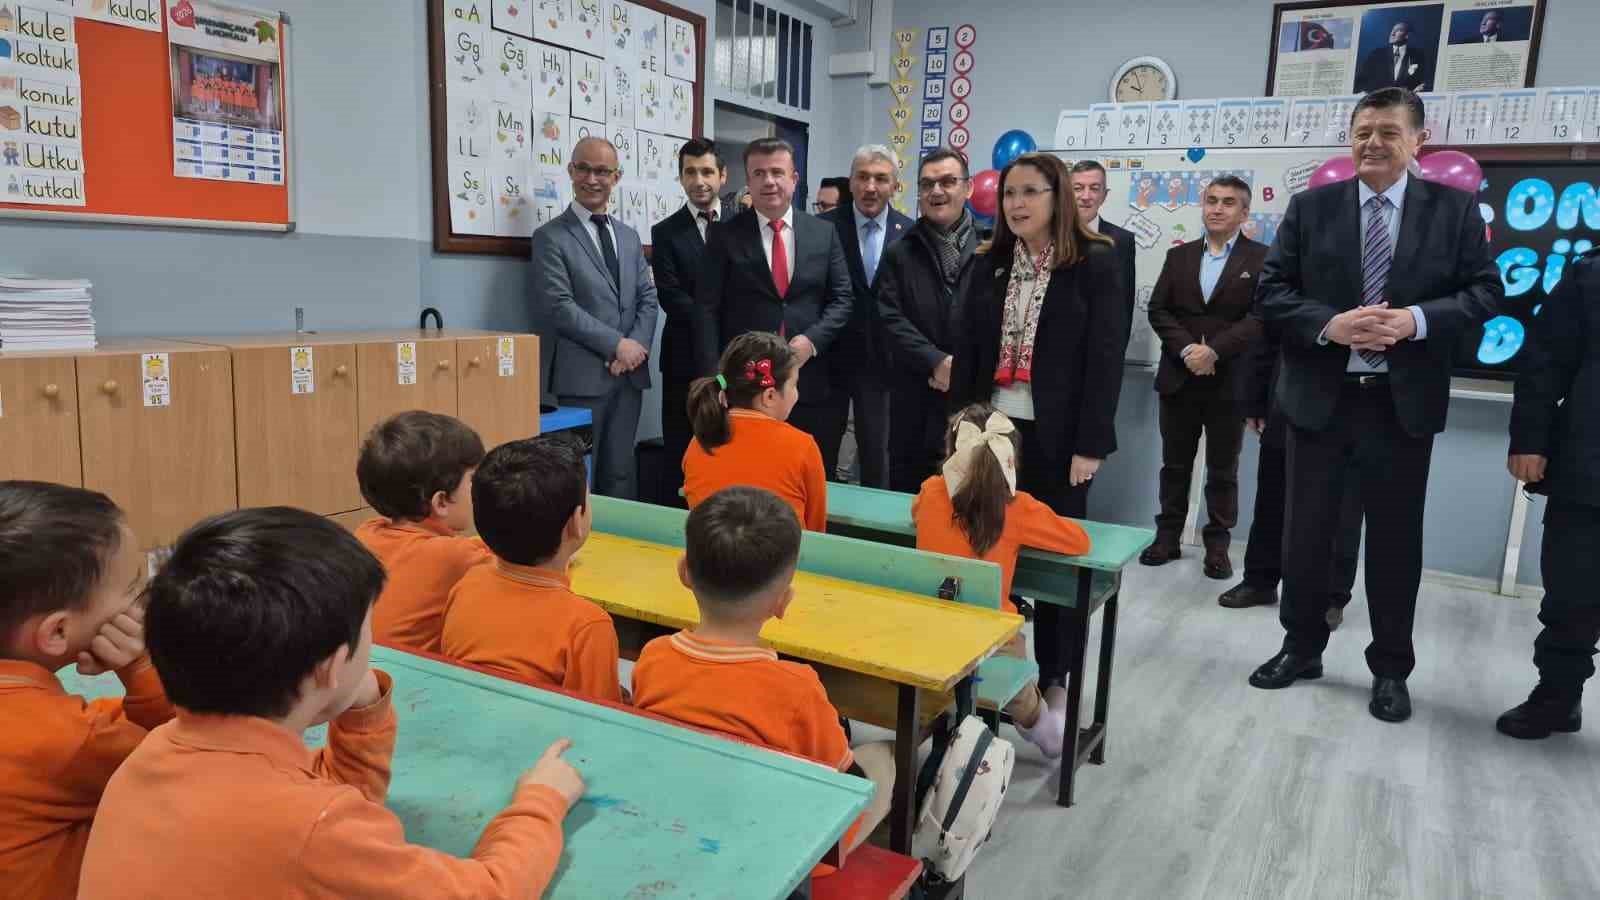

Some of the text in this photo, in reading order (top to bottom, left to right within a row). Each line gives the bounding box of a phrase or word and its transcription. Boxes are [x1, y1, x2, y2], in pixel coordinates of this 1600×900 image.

[109, 0, 158, 24] kulak
[612, 4, 628, 23] Dd
[17, 5, 66, 42] kule
[675, 23, 688, 41] Ff
[900, 32, 912, 43] 10
[961, 32, 968, 42] 2
[935, 35, 943, 44] 5
[457, 32, 480, 62] Gg
[503, 36, 525, 70] Ğğ
[16, 39, 73, 71] koltuk
[542, 50, 561, 73] Hh
[898, 57, 910, 68] 20
[931, 60, 943, 69] 10
[959, 58, 966, 67] 4
[19, 77, 75, 106] konuk
[929, 84, 941, 94] 15
[957, 84, 963, 93] 6
[497, 109, 524, 130] Mm
[895, 110, 906, 119] 40
[927, 109, 938, 118] 20
[955, 109, 962, 118] 8
[25, 104, 77, 138] kutu
[1301, 131, 1310, 143] 7
[1337, 131, 1346, 142] 8
[1465, 129, 1476, 140] 11
[1504, 126, 1520, 139] 12
[1552, 124, 1568, 138] 13
[614, 128, 630, 151] Öö
[894, 135, 905, 144] 50
[924, 132, 936, 143] 25
[953, 133, 965, 143] 10
[1066, 136, 1075, 146] 0
[1128, 133, 1136, 145] 2
[1160, 134, 1168, 145] 3
[1192, 134, 1202, 144] 4
[1227, 133, 1235, 145] 5
[1260, 131, 1270, 145] 6
[647, 138, 658, 161] Pp
[26, 143, 79, 171] Utku
[463, 170, 480, 190] Ss
[25, 175, 80, 200] tutkal
[1263, 186, 1274, 202] B
